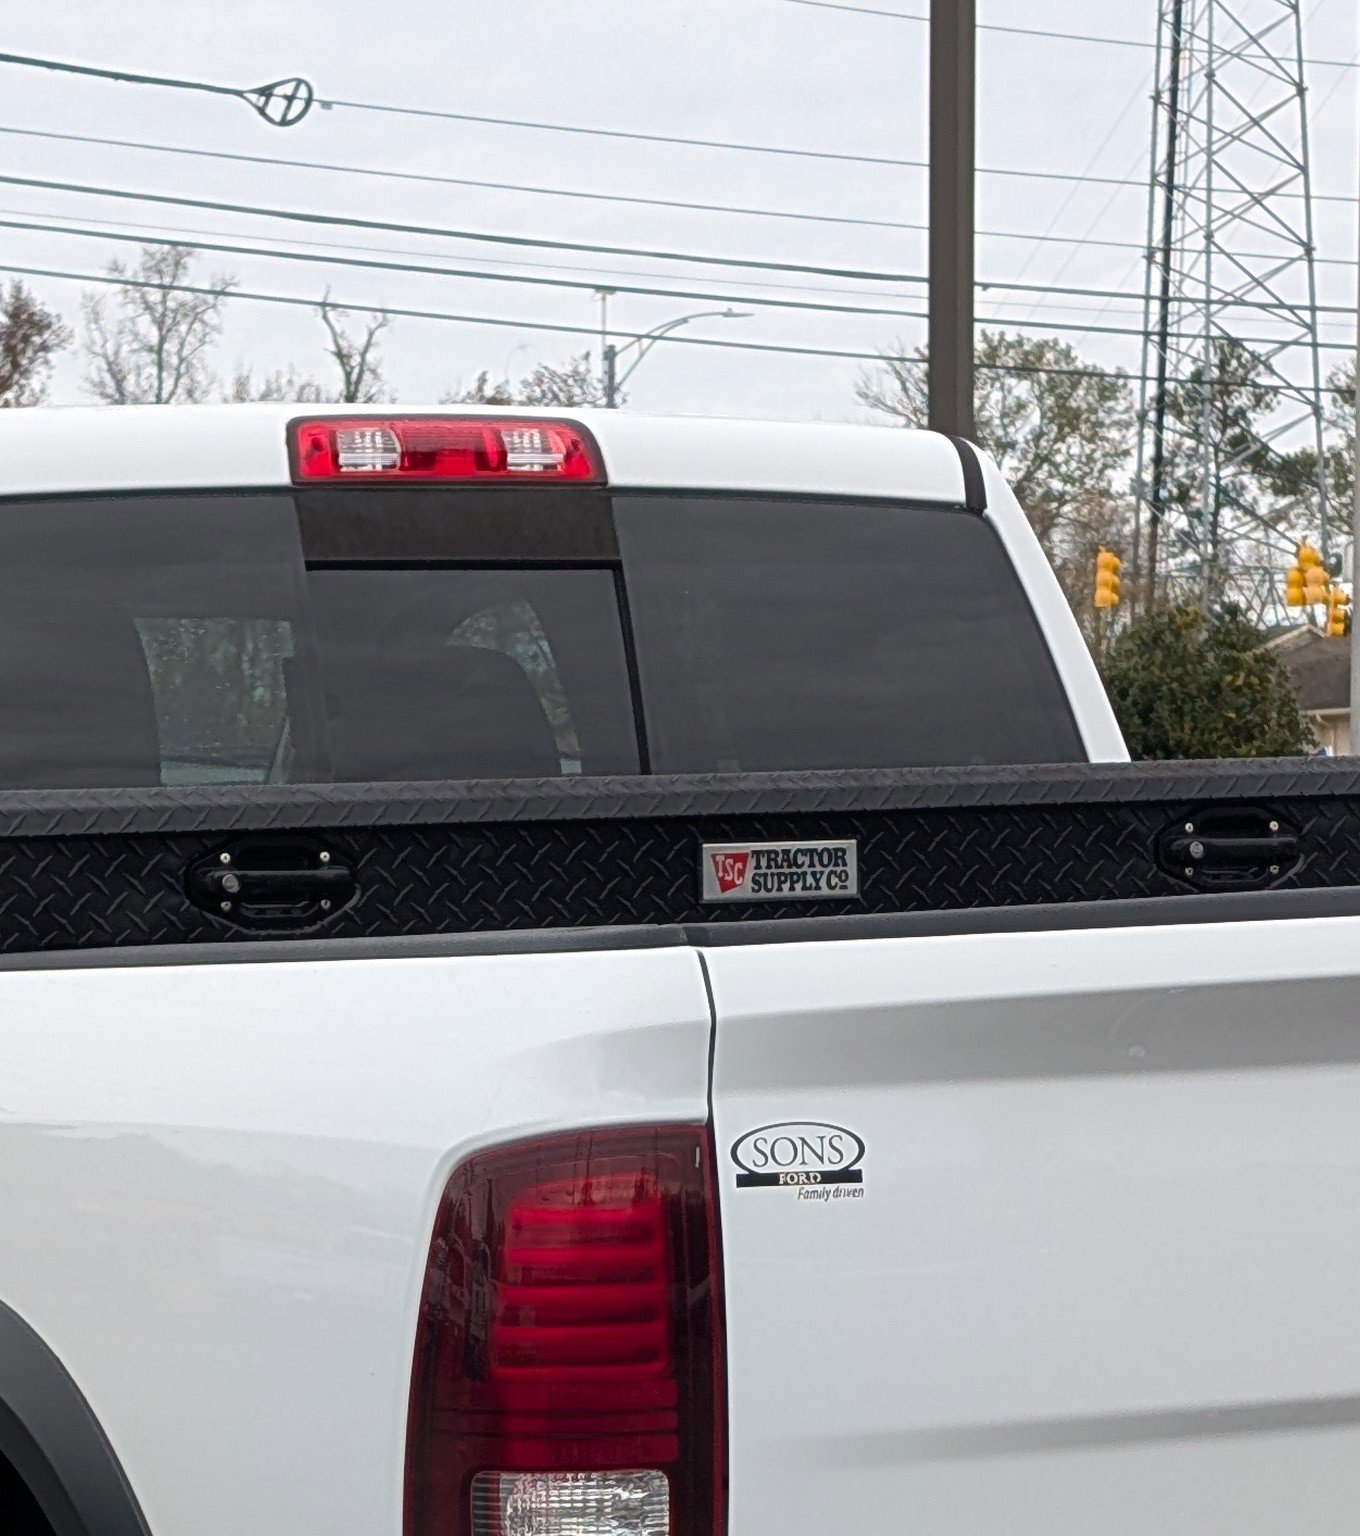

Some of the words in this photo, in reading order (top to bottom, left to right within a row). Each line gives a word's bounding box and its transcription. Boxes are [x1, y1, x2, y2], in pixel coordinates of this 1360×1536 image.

[715, 854, 743, 885] TSC
[751, 848, 848, 870] TRACTOR
[751, 871, 824, 894] SUPPLY
[752, 1135, 844, 1168] SONS
[778, 1172, 822, 1185] FORD
[798, 1186, 832, 1202] Family
[833, 1186, 864, 1199] driven
